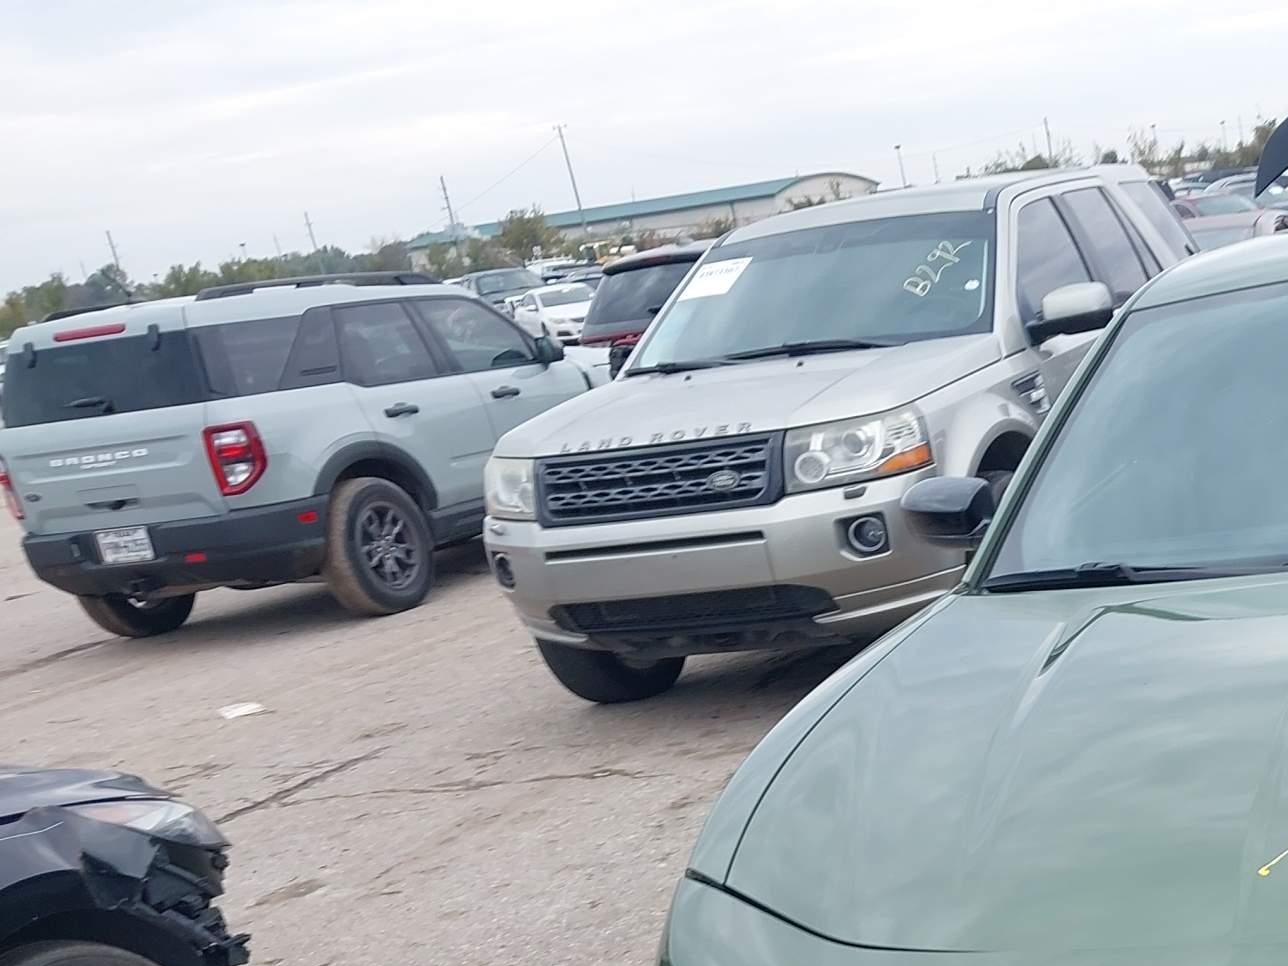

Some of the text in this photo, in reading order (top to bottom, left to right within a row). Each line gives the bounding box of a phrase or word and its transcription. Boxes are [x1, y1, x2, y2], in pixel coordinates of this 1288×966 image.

[559, 421, 753, 454] LAND ROVER
[48, 447, 149, 468] BRONCO
